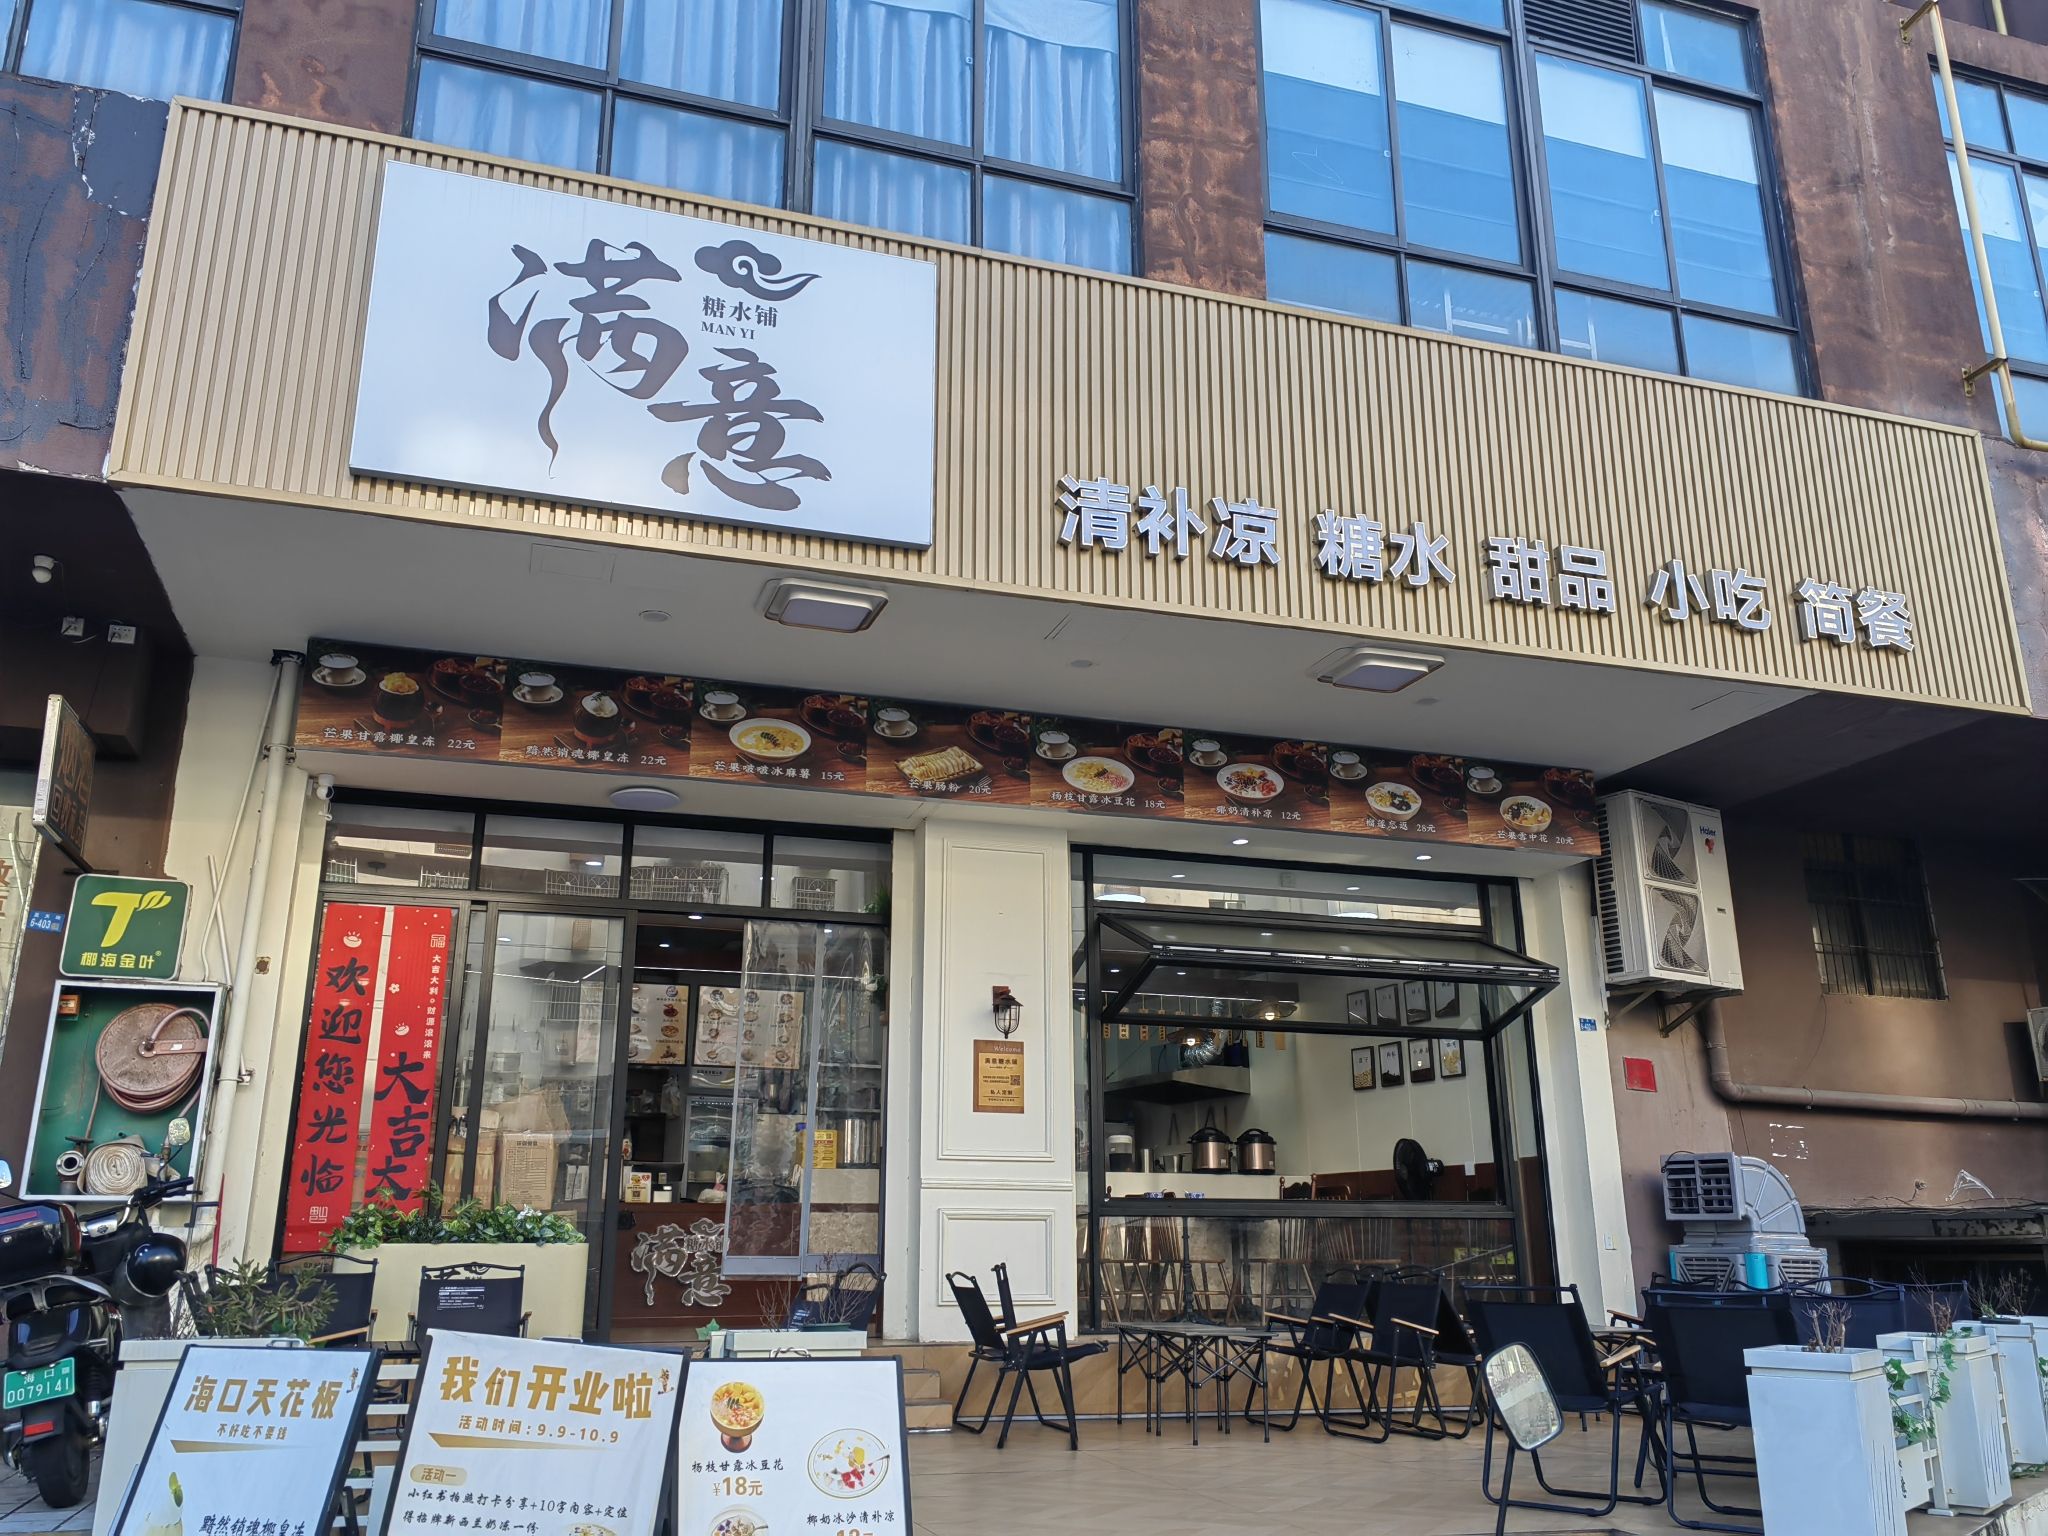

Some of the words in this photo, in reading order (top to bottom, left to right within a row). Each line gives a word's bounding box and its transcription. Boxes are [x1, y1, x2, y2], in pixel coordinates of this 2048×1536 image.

[701, 295, 778, 328] 糖水铺
[701, 321, 736, 338] MAN
[739, 326, 755, 340] YI
[488, 239, 832, 511] 满意
[1055, 473, 1280, 567] 清补凉
[1314, 508, 1456, 588] 糖水
[1484, 535, 1617, 615] 甜品
[1650, 559, 1772, 633] 小吃
[1797, 576, 1915, 653] 简餐
[323, 727, 436, 749] 芒果甘露椰皇冻
[447, 738, 476, 751] 22元
[640, 754, 668, 767] 22元
[820, 771, 846, 783] 15元
[908, 778, 961, 794] 芒果肠粉
[968, 784, 993, 796] 20元
[1051, 791, 1136, 809] 杨枝甘露冰豆花
[1144, 799, 1167, 810] 18元
[1281, 811, 1302, 822] 12元
[1416, 823, 1437, 834] 28元
[1556, 836, 1575, 846] 20元
[29, 917, 52, 930] 6-403
[80, 951, 155, 970] 椰海金叶
[993, 1045, 1021, 1053] Welcome
[301, 957, 369, 1197] 欢迎您光临
[7, 1377, 70, 1404] 0079141
[440, 1356, 653, 1419] 我们开业啦
[184, 1375, 343, 1420] 海口天花板
[216, 1424, 289, 1441] 不好吃不要钱
[420, 1467, 457, 1482] 活动一
[692, 1458, 784, 1473] 杨枝甘露冰豆花
[407, 1488, 628, 1519] 小红书拍照打卡分享+10字内容+定位
[806, 1510, 895, 1527] 椰奶冰沙清补凉
